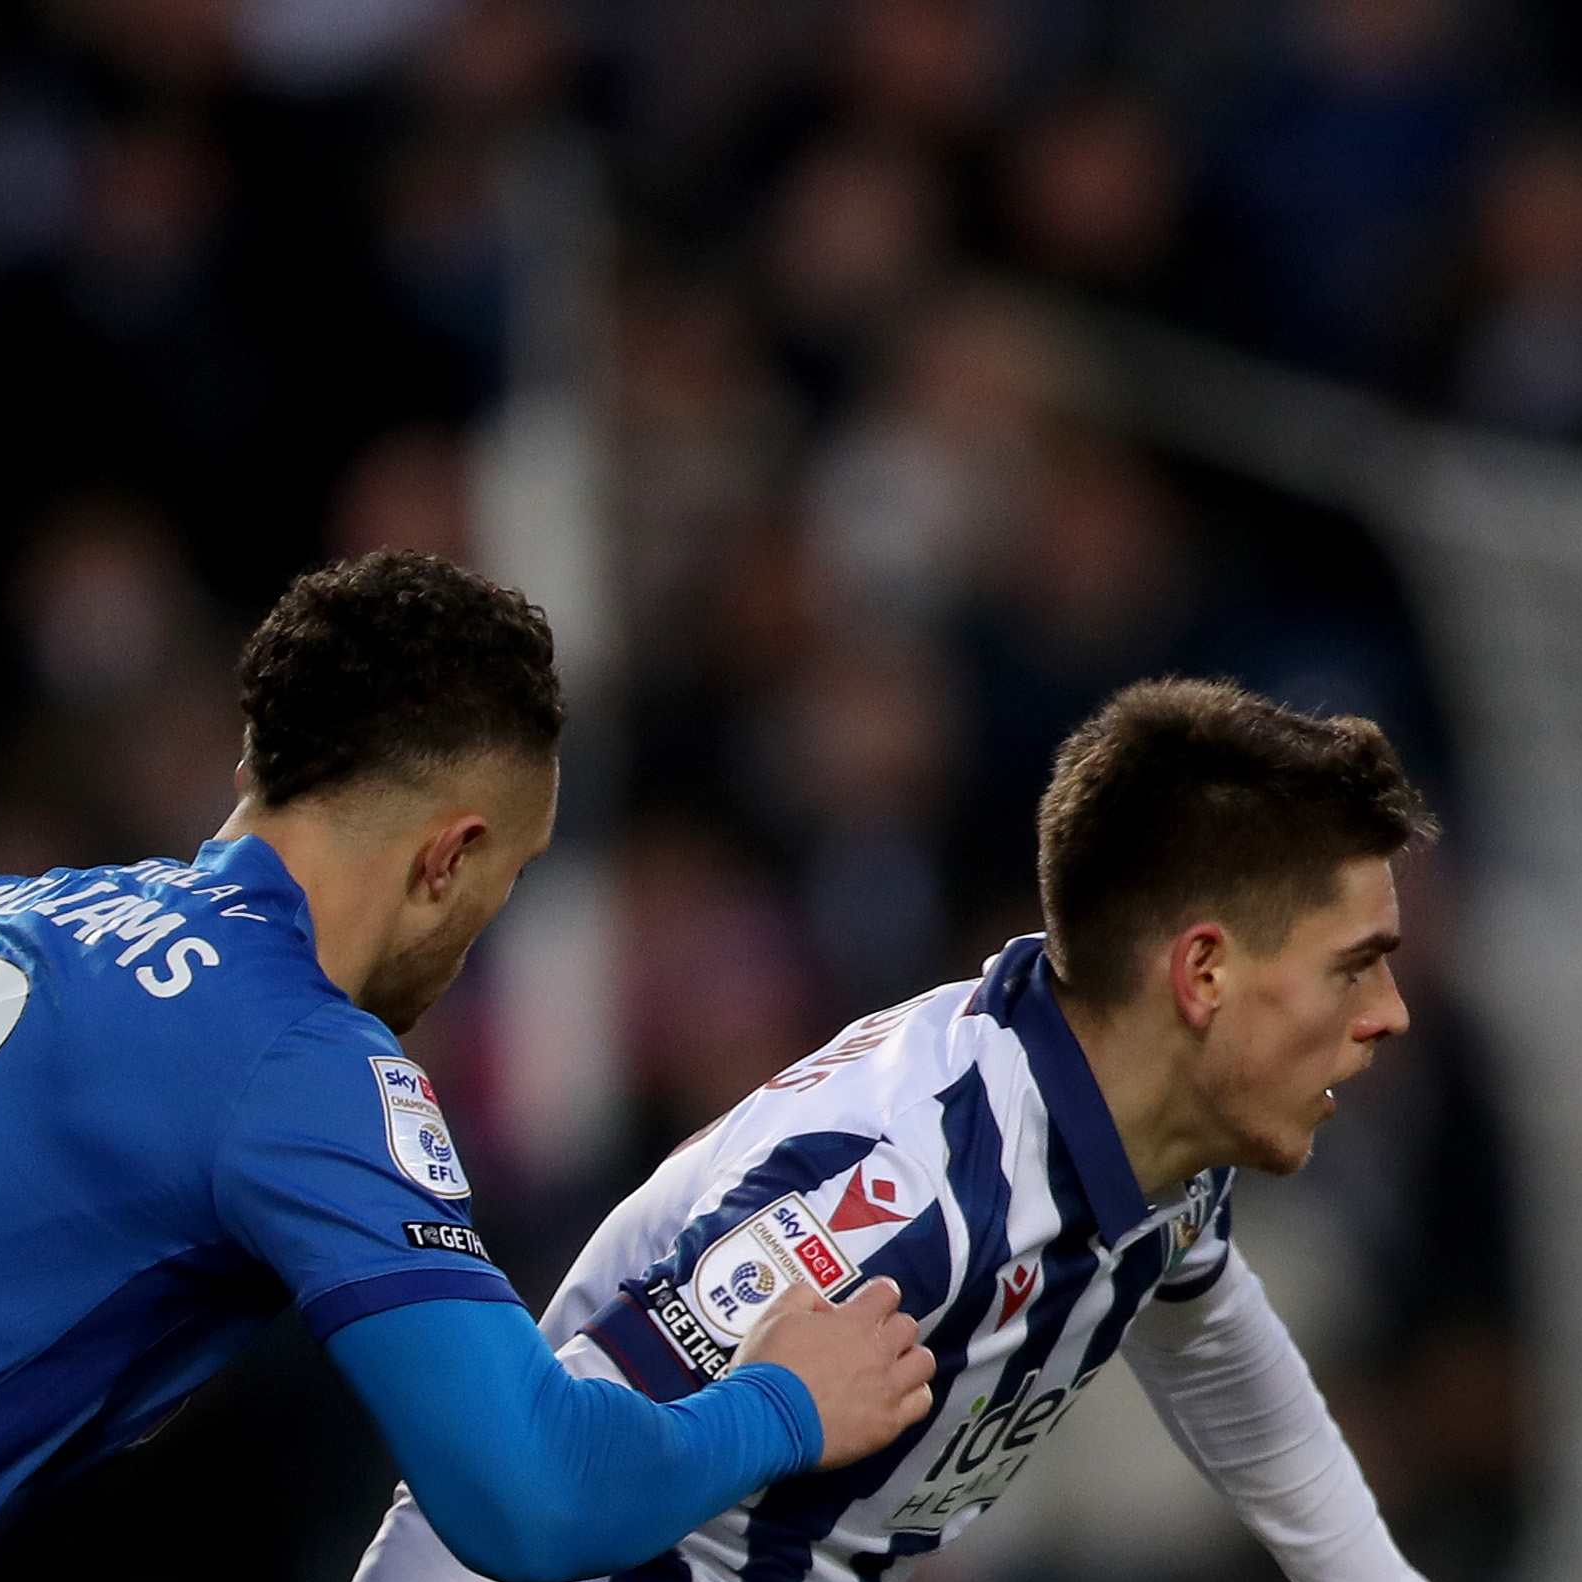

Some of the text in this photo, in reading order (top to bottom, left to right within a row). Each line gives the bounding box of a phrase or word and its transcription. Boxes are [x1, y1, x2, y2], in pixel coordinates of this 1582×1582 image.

[384, 1068, 417, 1094] sky
[428, 1163, 459, 1184] EFL
[772, 1206, 841, 1282] sky bet
[708, 1284, 741, 1322] EFL
